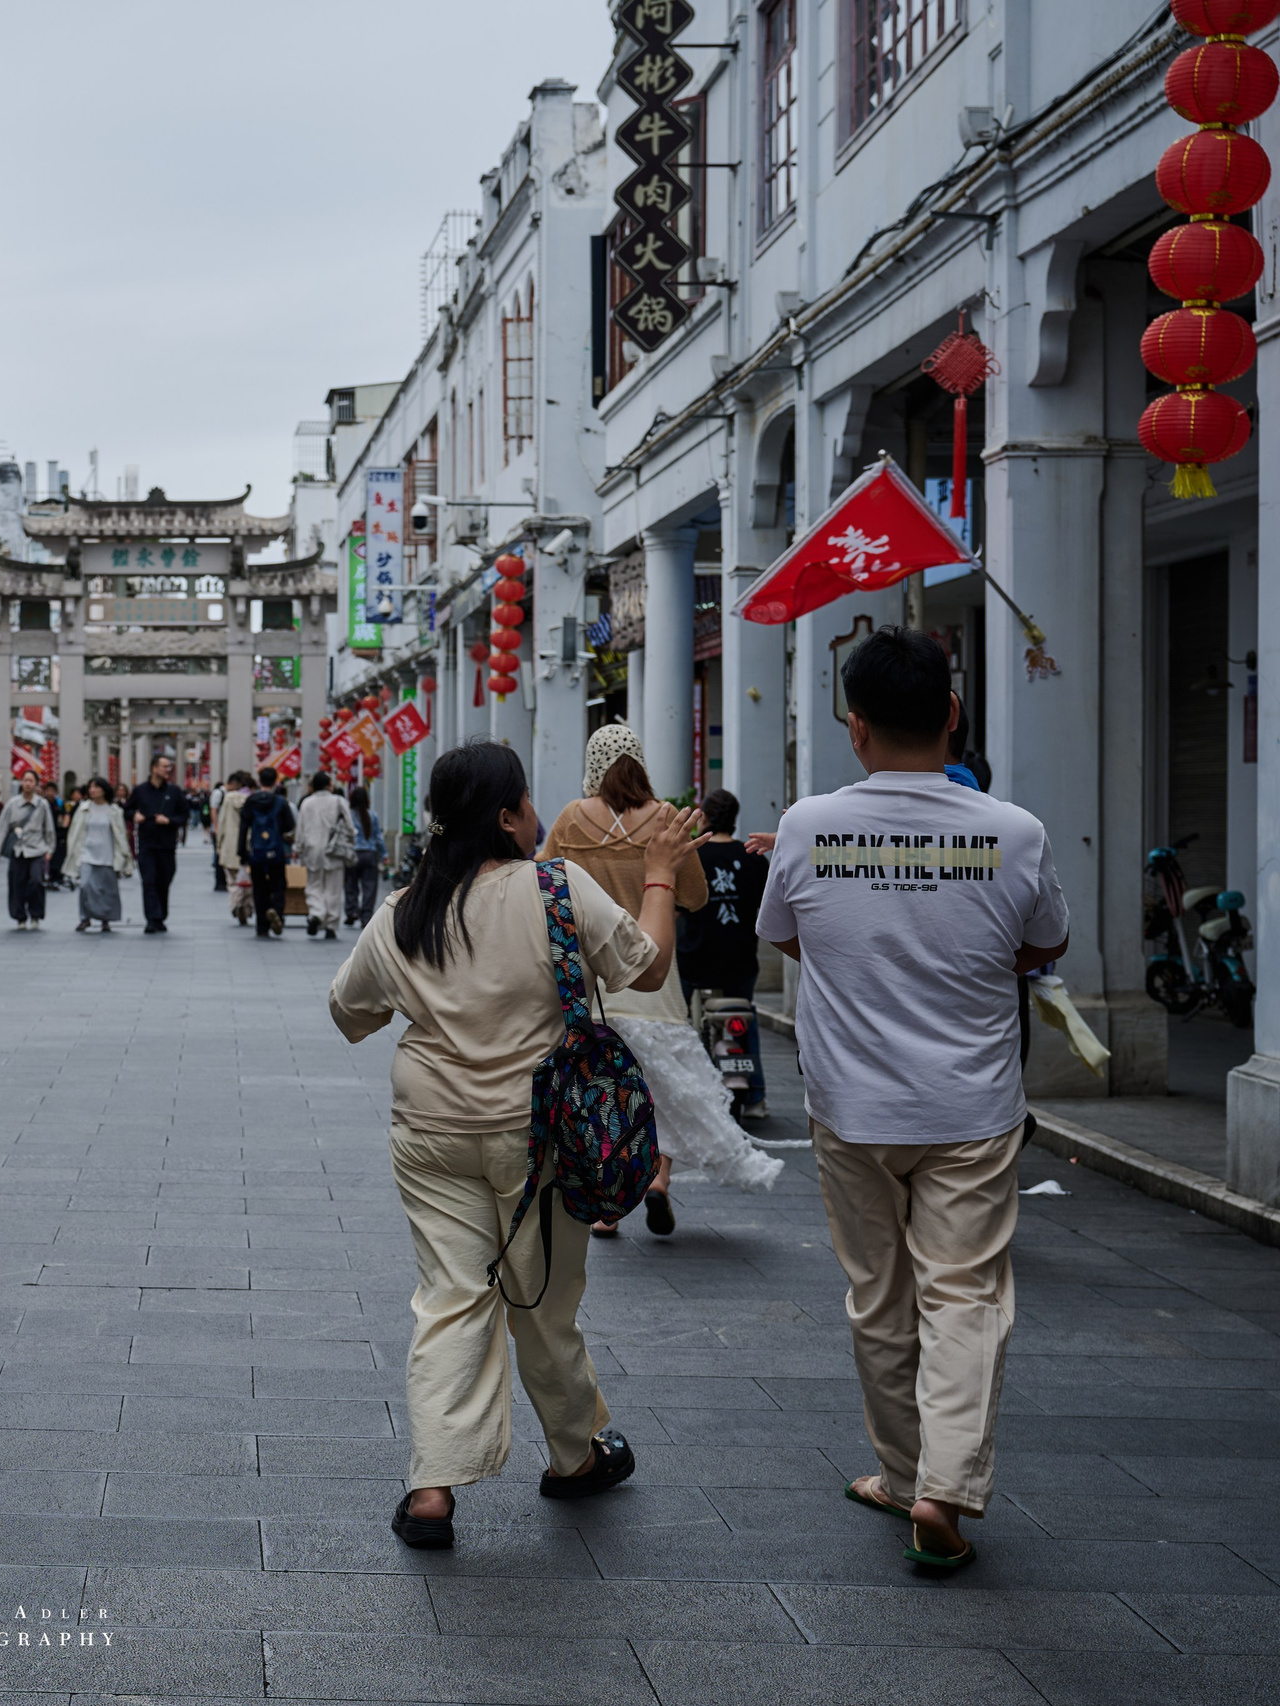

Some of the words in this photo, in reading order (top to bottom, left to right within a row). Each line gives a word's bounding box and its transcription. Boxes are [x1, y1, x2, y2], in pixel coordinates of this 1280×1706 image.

[815, 834, 886, 879] BREAK
[890, 835, 934, 880] THE
[939, 835, 999, 881] LIMIT
[871, 883, 890, 891] G.S
[893, 883, 938, 892] TIDE-98
